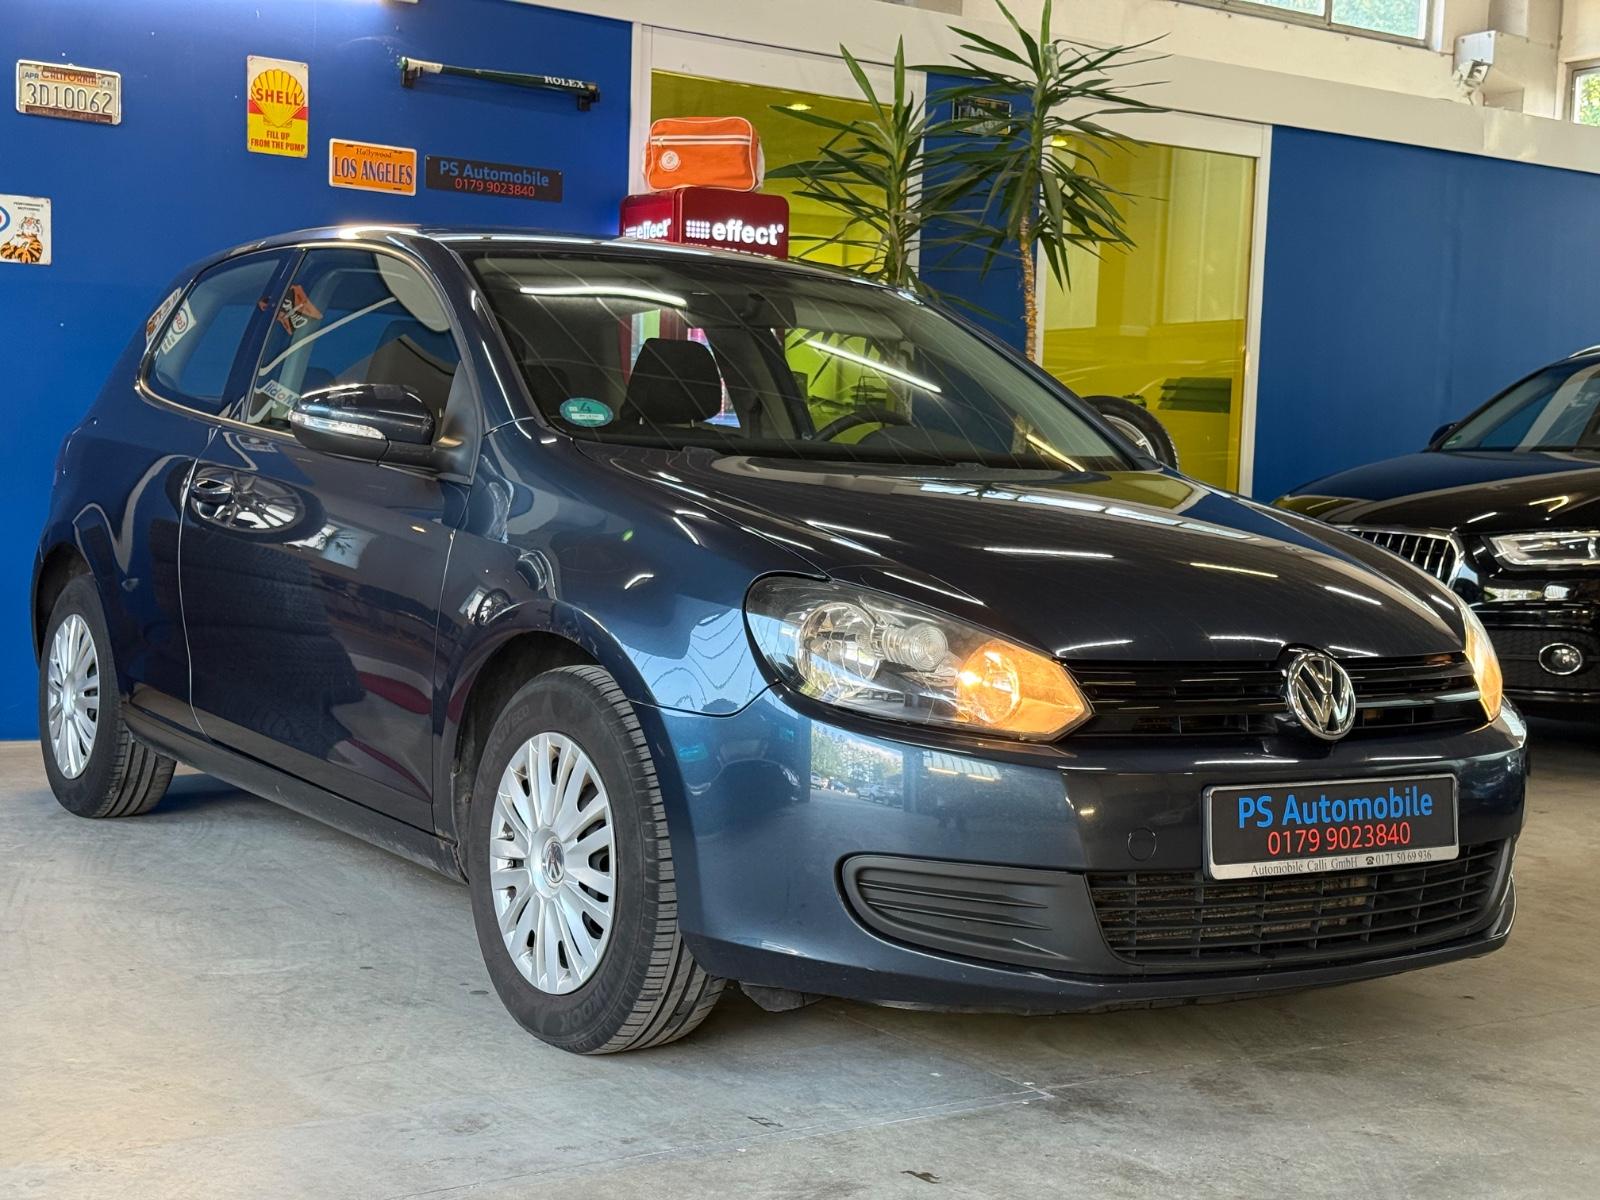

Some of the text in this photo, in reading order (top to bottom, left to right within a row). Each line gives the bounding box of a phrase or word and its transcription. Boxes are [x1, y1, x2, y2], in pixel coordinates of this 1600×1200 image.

[544, 75, 586, 89] ROLEX
[26, 83, 113, 114] 3D10062
[255, 87, 301, 107] SHELL
[250, 138, 306, 152] FROM THE PUMP
[266, 130, 291, 141] FILL UP
[355, 147, 393, 159] Hollywood
[333, 156, 413, 186] LOS ANGELES
[438, 160, 550, 188] PS Automobile
[454, 177, 536, 198] 0179 9023840
[711, 218, 780, 246] effect
[1238, 785, 1434, 830] PS Automobile
[1267, 820, 1412, 856] 0179 9023840
[1251, 861, 1303, 876] Automobile
[1307, 859, 1328, 871] Calli
[1331, 856, 1358, 869] GmbH
